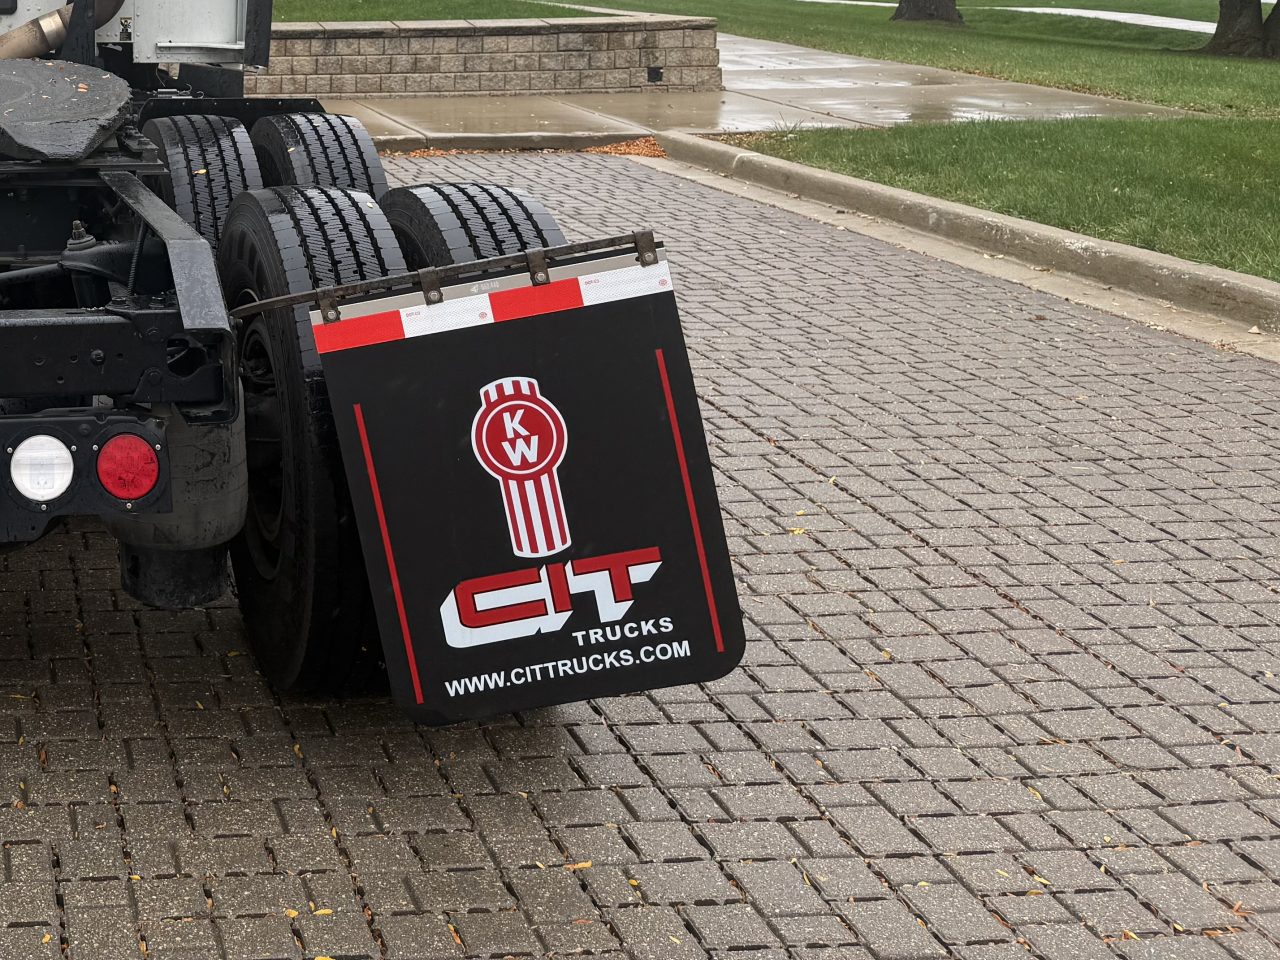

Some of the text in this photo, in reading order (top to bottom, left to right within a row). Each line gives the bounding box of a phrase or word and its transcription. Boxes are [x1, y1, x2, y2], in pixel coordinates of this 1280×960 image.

[440, 546, 662, 648] CIT
[572, 617, 674, 646] TRUCKS
[445, 640, 691, 697] WWW.CITTRUCKS.COM
